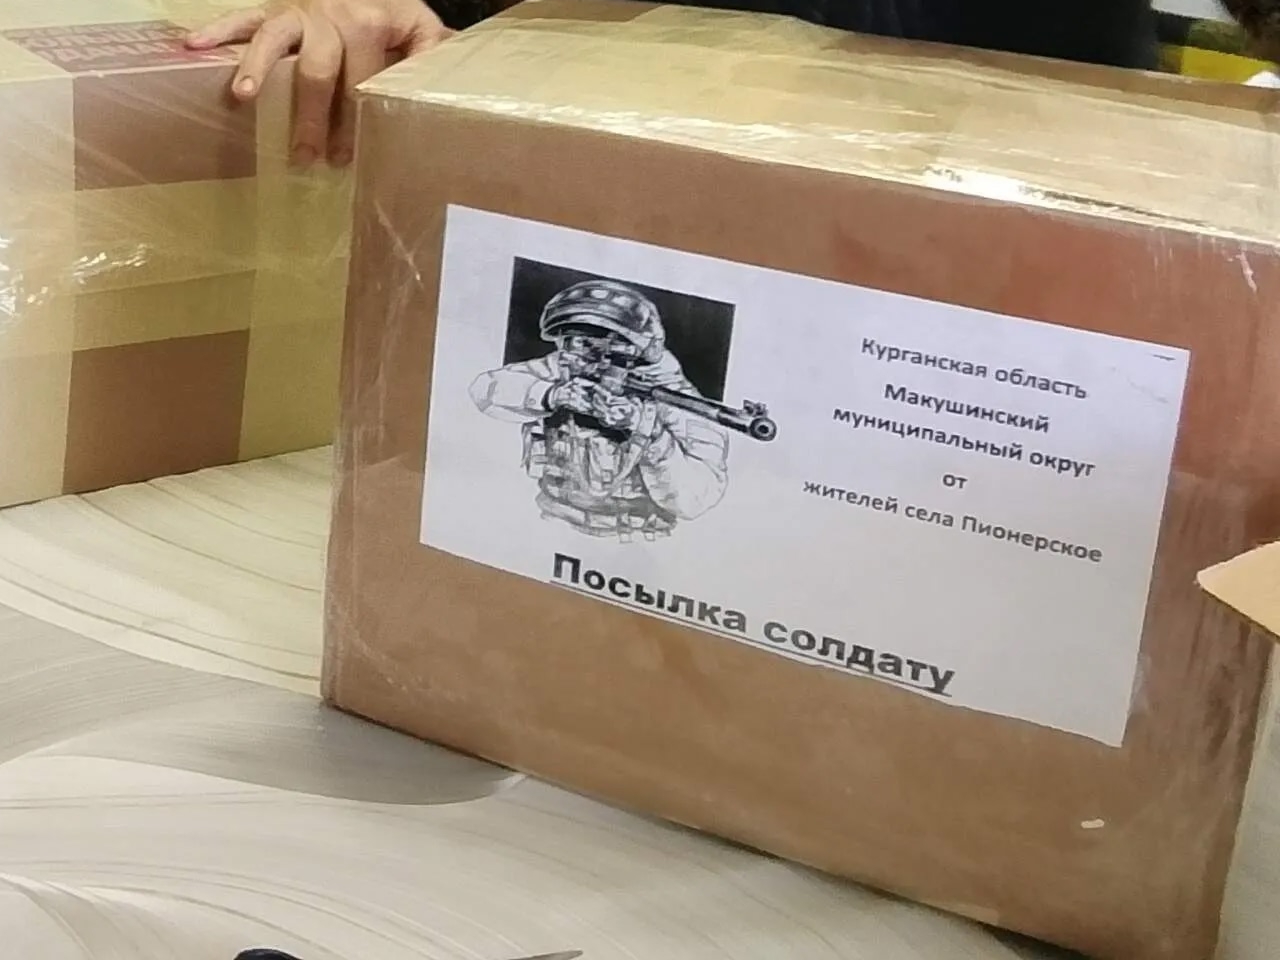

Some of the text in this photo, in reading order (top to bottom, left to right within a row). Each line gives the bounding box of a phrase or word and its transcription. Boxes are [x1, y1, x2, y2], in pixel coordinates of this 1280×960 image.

[861, 338, 1087, 400] Курганская область
[884, 383, 1049, 433] Макушинский
[832, 407, 1096, 478] муниципальный округ
[942, 473, 968, 489] от
[803, 480, 1102, 562] жителей села Пионерское
[553, 552, 956, 696] Посылка солдату
